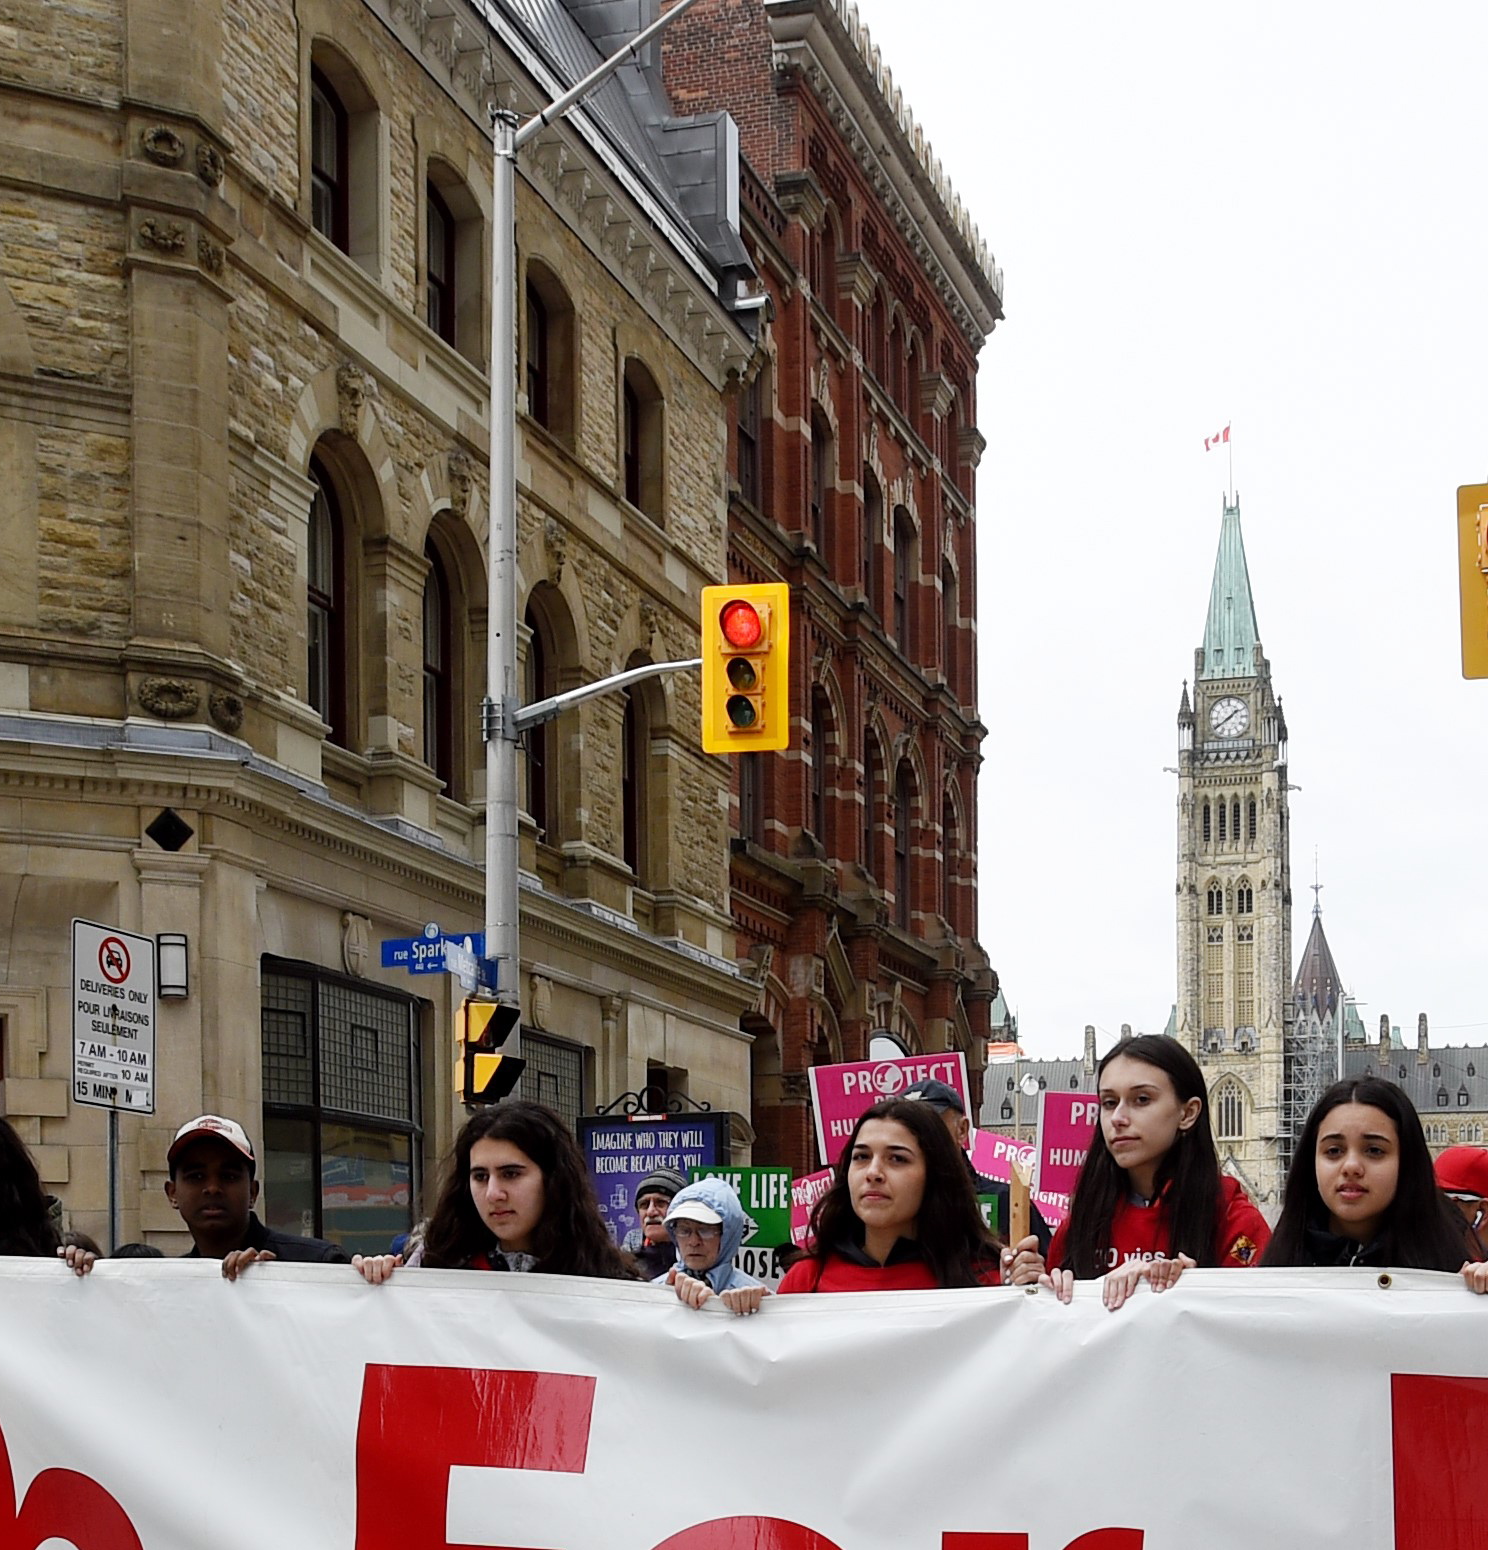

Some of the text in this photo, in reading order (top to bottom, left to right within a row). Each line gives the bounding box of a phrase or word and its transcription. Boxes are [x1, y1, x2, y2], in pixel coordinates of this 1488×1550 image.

[393, 937, 463, 963] rue Spark
[80, 978, 148, 1005] DELIVERIES ONLY
[77, 1000, 150, 1027] POUR LIVRAISONS
[91, 1019, 138, 1040] SEULEMENT
[80, 1041, 86, 1055] 7
[88, 1044, 106, 1059] AM
[117, 1049, 128, 1063] 10
[129, 1052, 147, 1067] AM
[76, 1080, 88, 1096] 15
[77, 1068, 149, 1084] REQUIRED AFTER 10 AM
[843, 1061, 955, 1096] PROTECT
[592, 1130, 704, 1151] IMAGINE WHO THEY WILL
[595, 1155, 628, 1174] BECOME
[630, 1154, 667, 1173] BECAUSE
[668, 1153, 681, 1170] OF
[750, 1173, 788, 1208] LIFE
